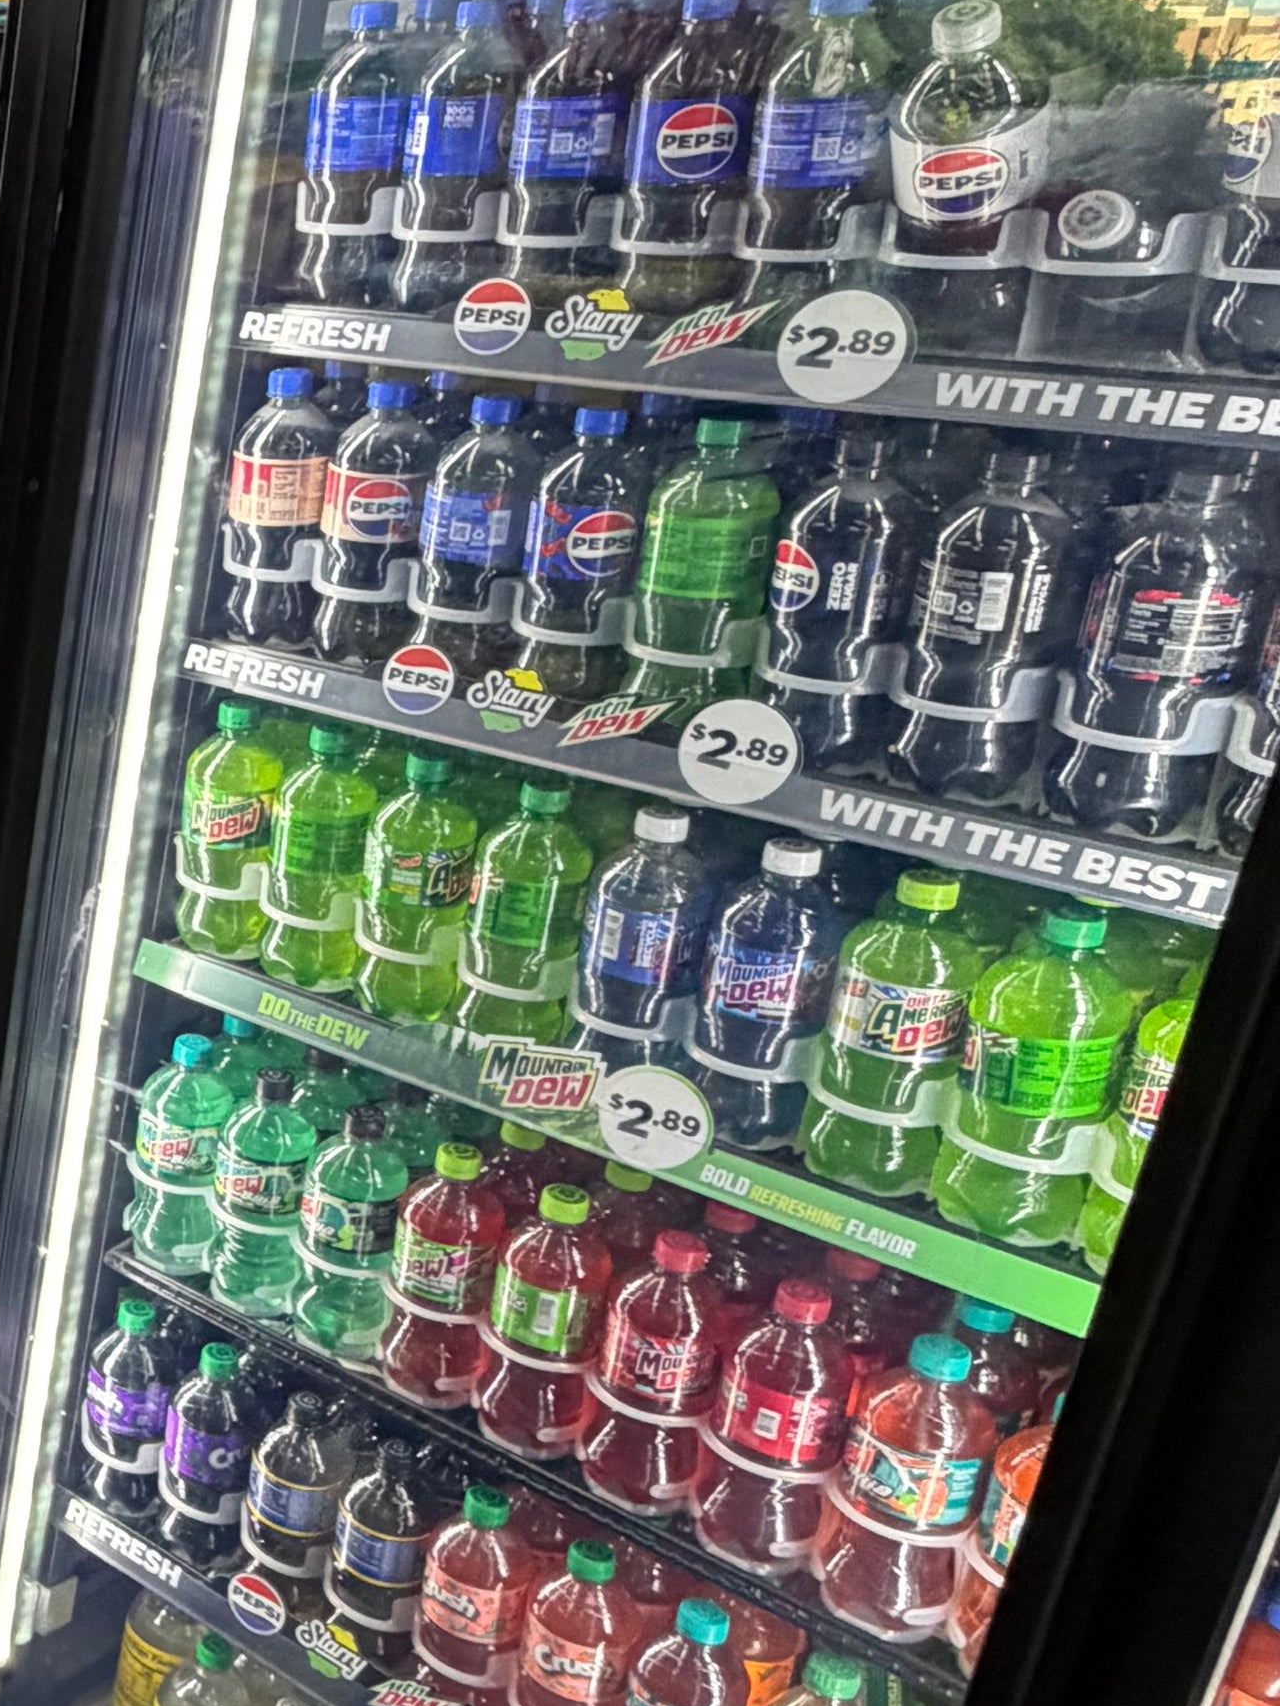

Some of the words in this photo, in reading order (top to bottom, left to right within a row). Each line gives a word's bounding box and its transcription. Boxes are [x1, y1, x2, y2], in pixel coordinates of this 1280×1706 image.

[662, 131, 737, 152] PEPSI
[919, 163, 1003, 192] PEPSI
[240, 311, 391, 352] REFRESH
[459, 307, 526, 328] PEPSI
[545, 294, 644, 351] Starry
[786, 323, 896, 370] $2.89
[935, 373, 1083, 417] WITH
[1094, 386, 1213, 429] THE
[349, 498, 412, 516] PEPSI
[571, 533, 635, 553] PEPSI
[826, 562, 846, 611] ZERO
[839, 562, 859, 611] SUGAR
[183, 643, 326, 700] REFRESH
[388, 667, 450, 695] PEPSI
[466, 672, 558, 728] Starry
[690, 721, 788, 771] $2.89
[819, 789, 956, 849] WITH
[964, 819, 1064, 876] THE
[1072, 845, 1229, 911] BEST
[258, 991, 289, 1019] DO
[289, 1009, 318, 1031] THE
[317, 1014, 371, 1051] DEW
[608, 1094, 702, 1140] $2.89
[699, 1164, 750, 1196] BOLD
[749, 1181, 844, 1233] REFRESHING
[844, 1218, 919, 1261] FLAVOR
[65, 1497, 184, 1589] REFRESH
[231, 1586, 284, 1625] PEPSI
[295, 1618, 369, 1683] Starry
